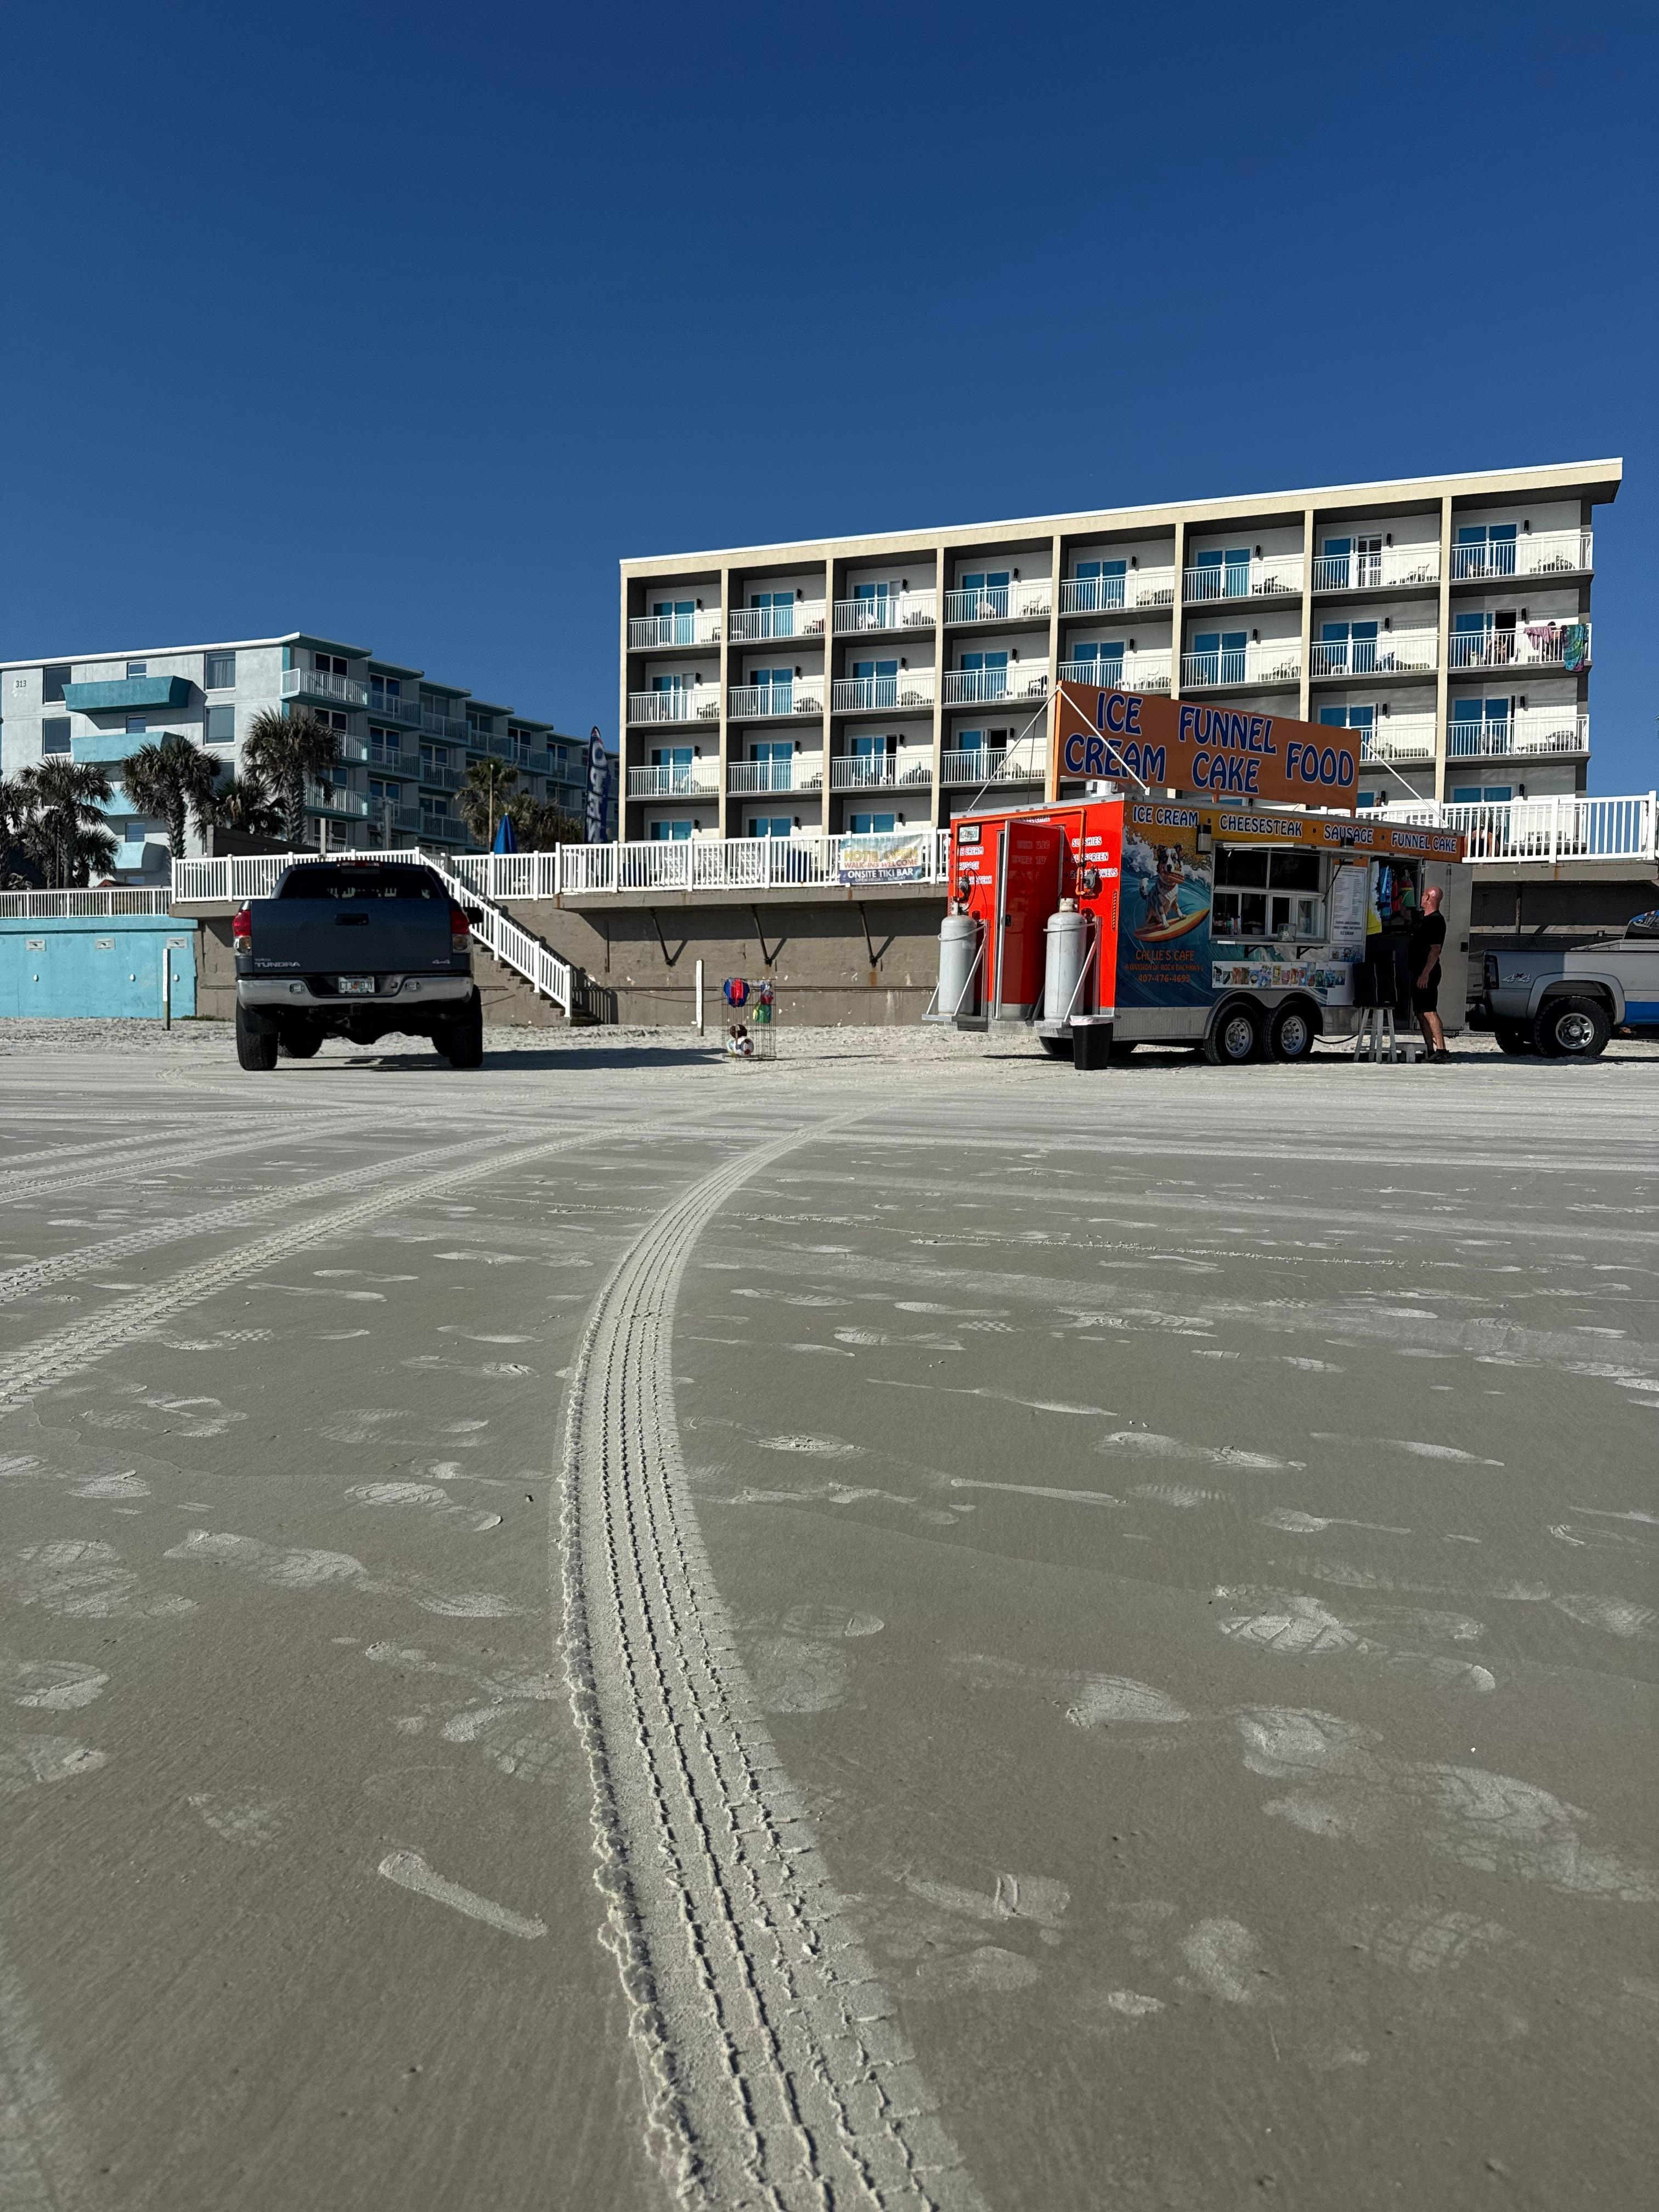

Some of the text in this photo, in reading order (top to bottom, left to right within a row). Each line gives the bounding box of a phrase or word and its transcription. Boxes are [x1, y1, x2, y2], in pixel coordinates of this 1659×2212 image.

[1097, 691, 1142, 736] ICE
[1178, 704, 1277, 755] FUNNEL
[1065, 733, 1166, 783] CREAM
[1286, 742, 1355, 788] FOOD
[1192, 751, 1261, 794] CAKE
[1133, 805, 1199, 827] ICE CREAM
[1219, 814, 1303, 837] CHEESESTEAK
[1073, 837, 1102, 847] SLSHIES
[1324, 824, 1374, 844] SAUSAGE
[1391, 832, 1457, 853] FUNNEL CAKE
[844, 847, 918, 861] HOTEL OPEN
[1071, 853, 1109, 864] SUSCREEN
[848, 870, 877, 878] ONSITE
[878, 870, 894, 878] TIKI
[1096, 868, 1118, 877] OWELS
[1136, 950, 1194, 961] CALLIE'S CAFE
